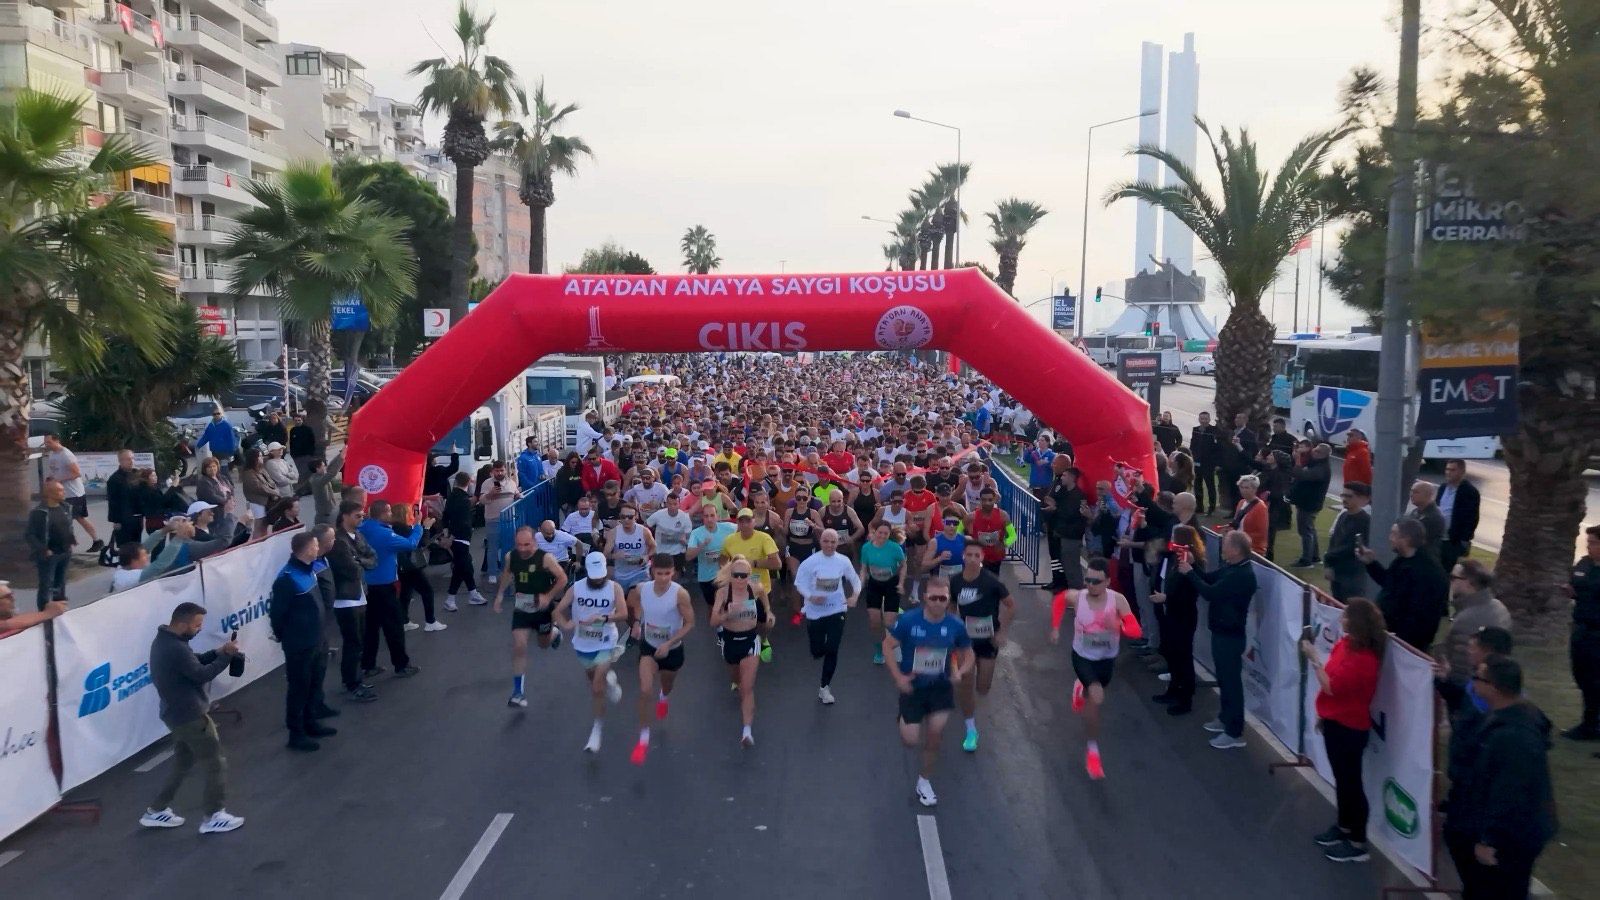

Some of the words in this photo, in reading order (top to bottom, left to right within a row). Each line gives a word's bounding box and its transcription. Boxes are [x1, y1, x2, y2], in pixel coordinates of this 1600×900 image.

[565, 279, 667, 296] ATA'DAN
[674, 278, 764, 296] ANA'YA
[772, 277, 841, 295] SAYGI
[850, 274, 946, 299] KOŞUSU
[333, 306, 356, 315] TEKEL
[618, 542, 642, 550] BOLD
[577, 598, 610, 608] BOLD
